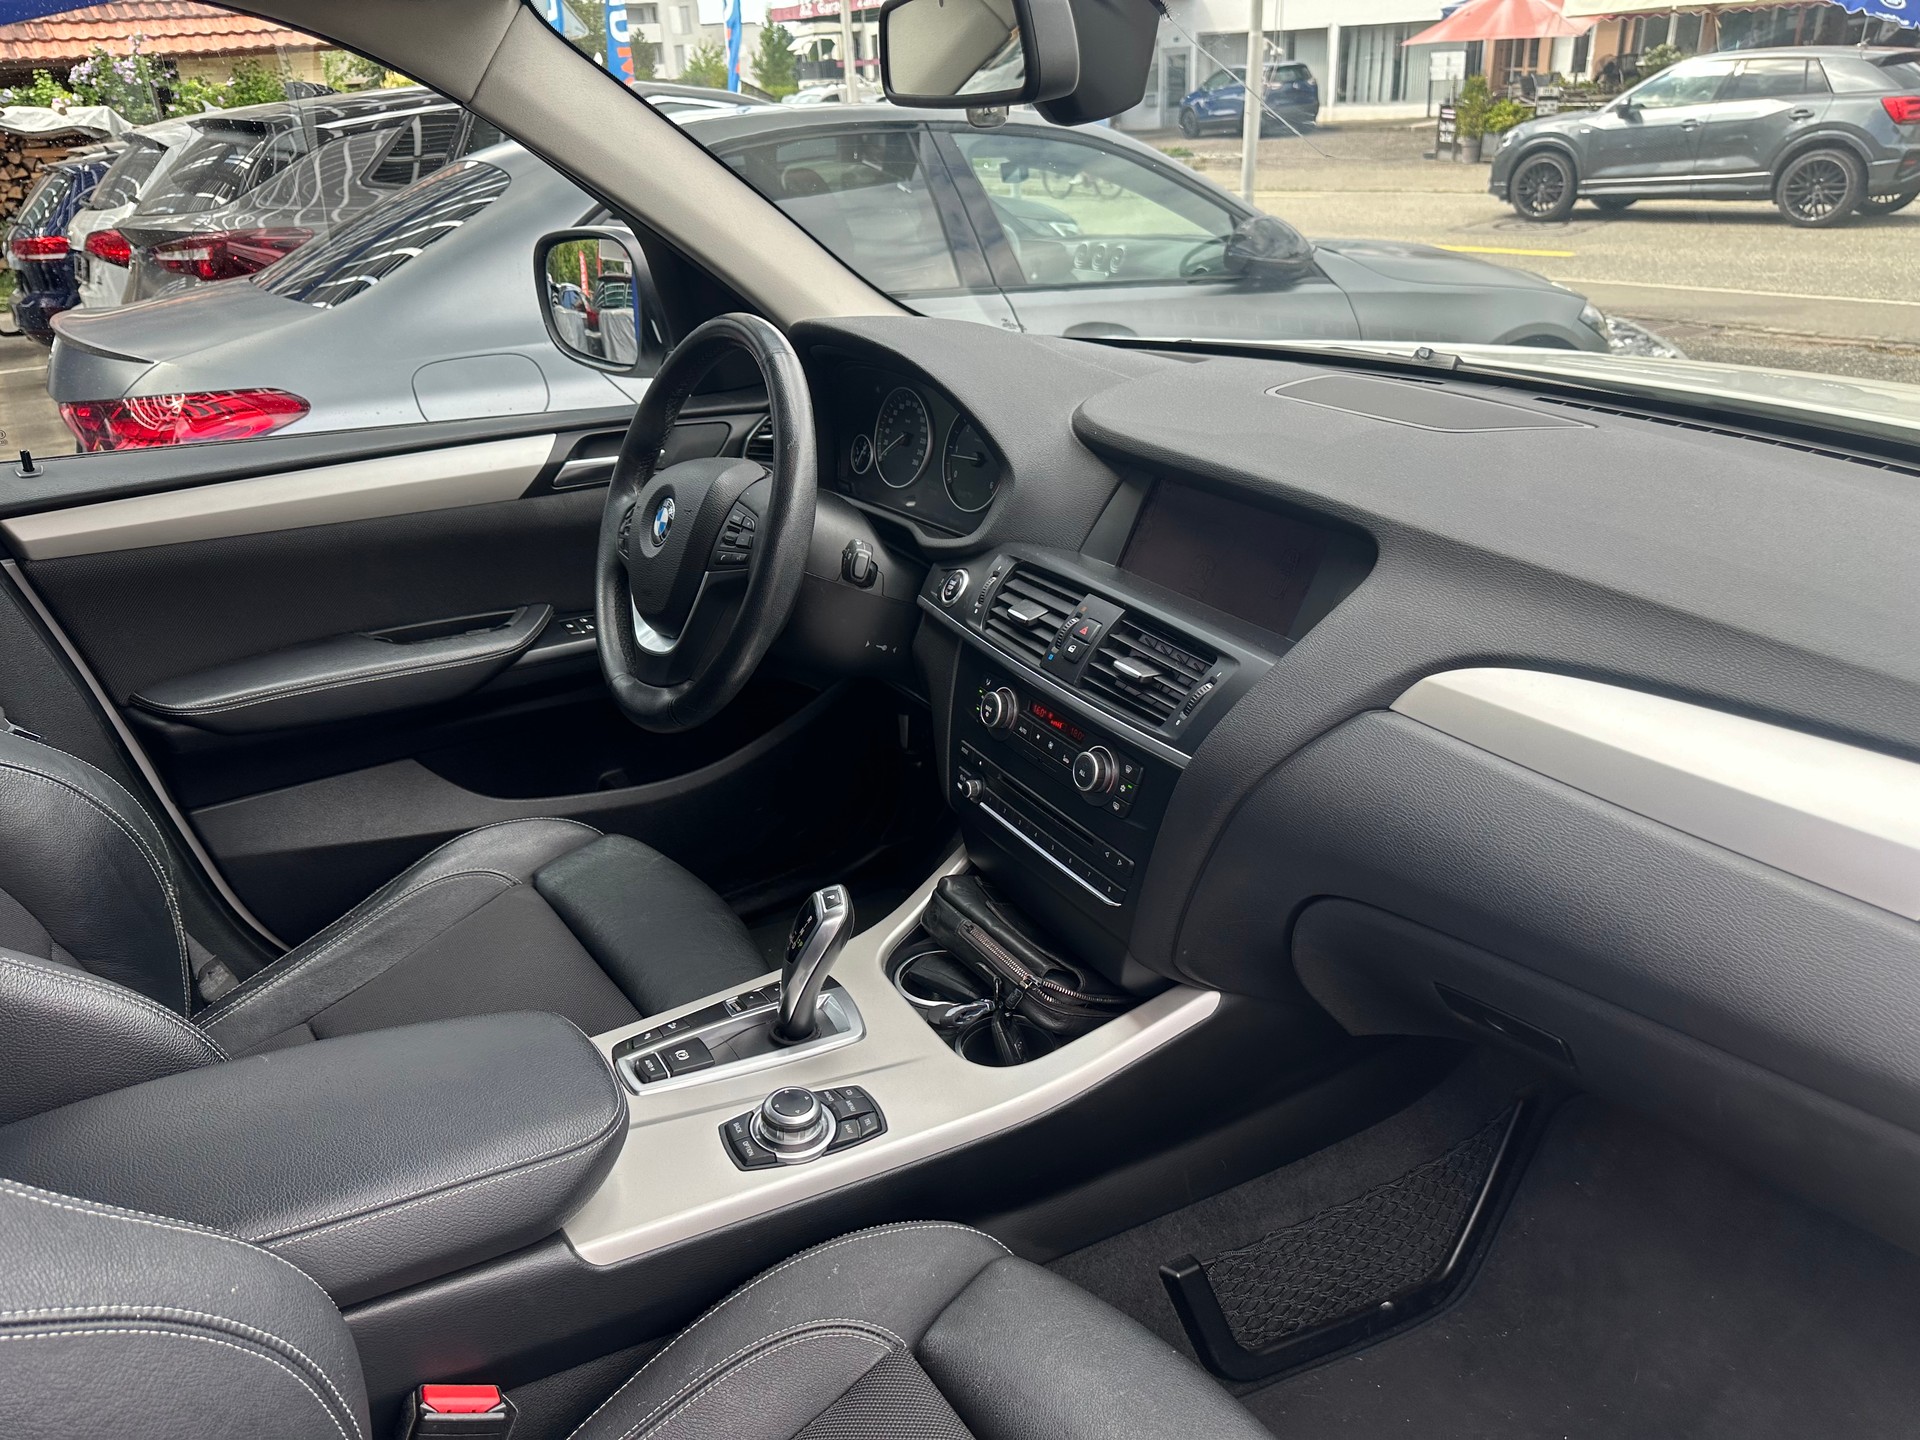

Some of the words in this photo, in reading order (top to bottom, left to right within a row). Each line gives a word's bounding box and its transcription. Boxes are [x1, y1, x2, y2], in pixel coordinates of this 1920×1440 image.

[845, 1100, 856, 1112] MENU
[733, 1121, 743, 1134] BACK
[845, 1124, 854, 1134] NAV
[742, 1140, 755, 1157] OPTION
